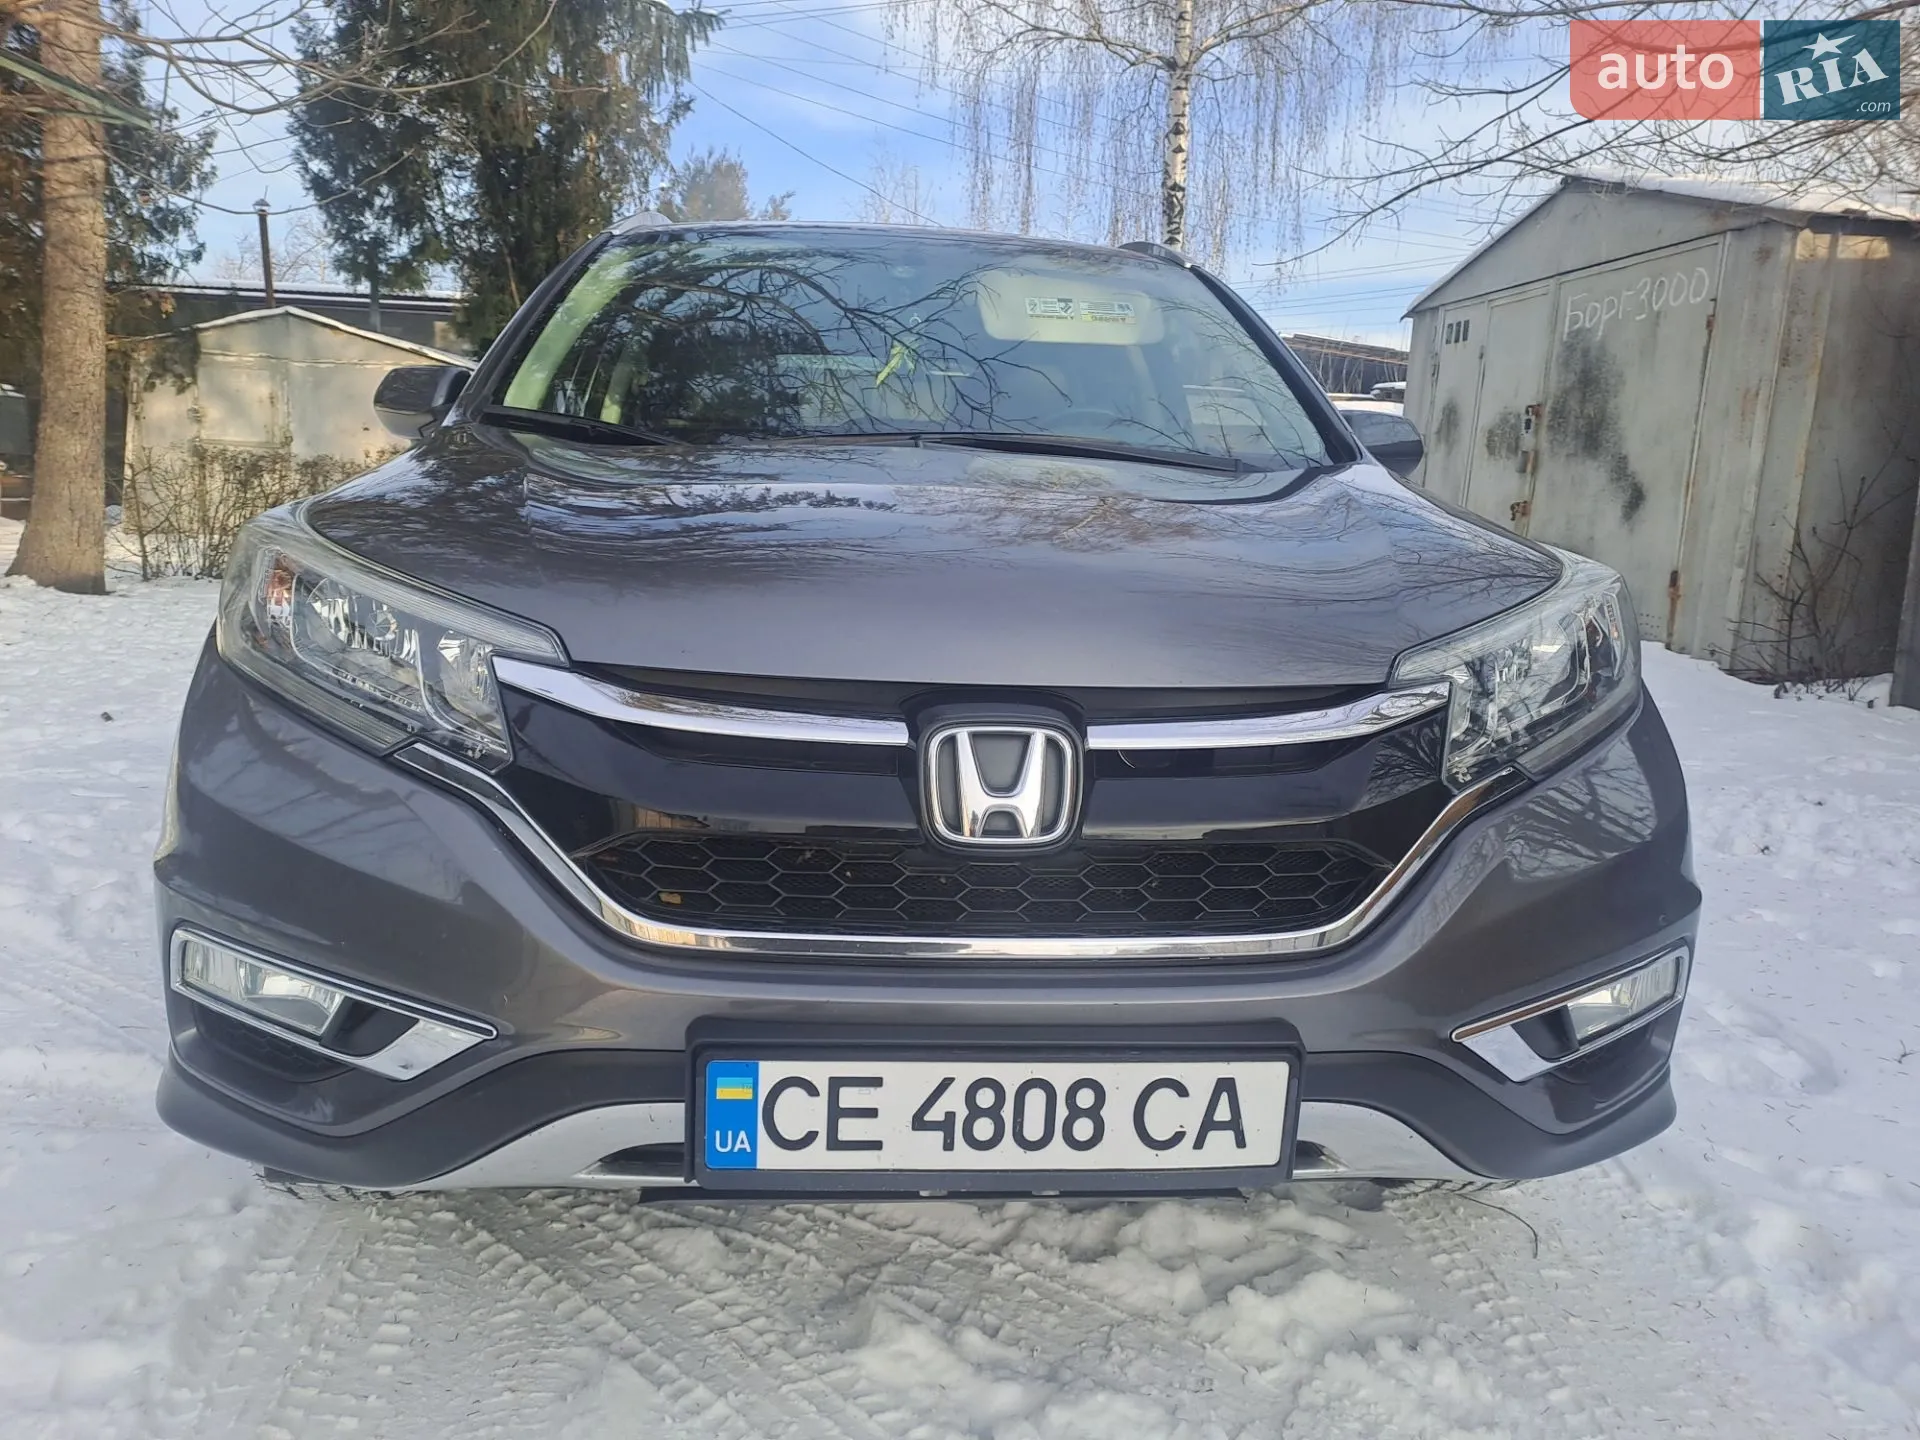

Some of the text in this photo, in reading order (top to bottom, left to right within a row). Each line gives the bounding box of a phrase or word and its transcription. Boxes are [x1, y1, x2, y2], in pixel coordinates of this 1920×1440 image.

[762, 1076, 1247, 1152] CE 4808 CA
[715, 1130, 752, 1153] UA
